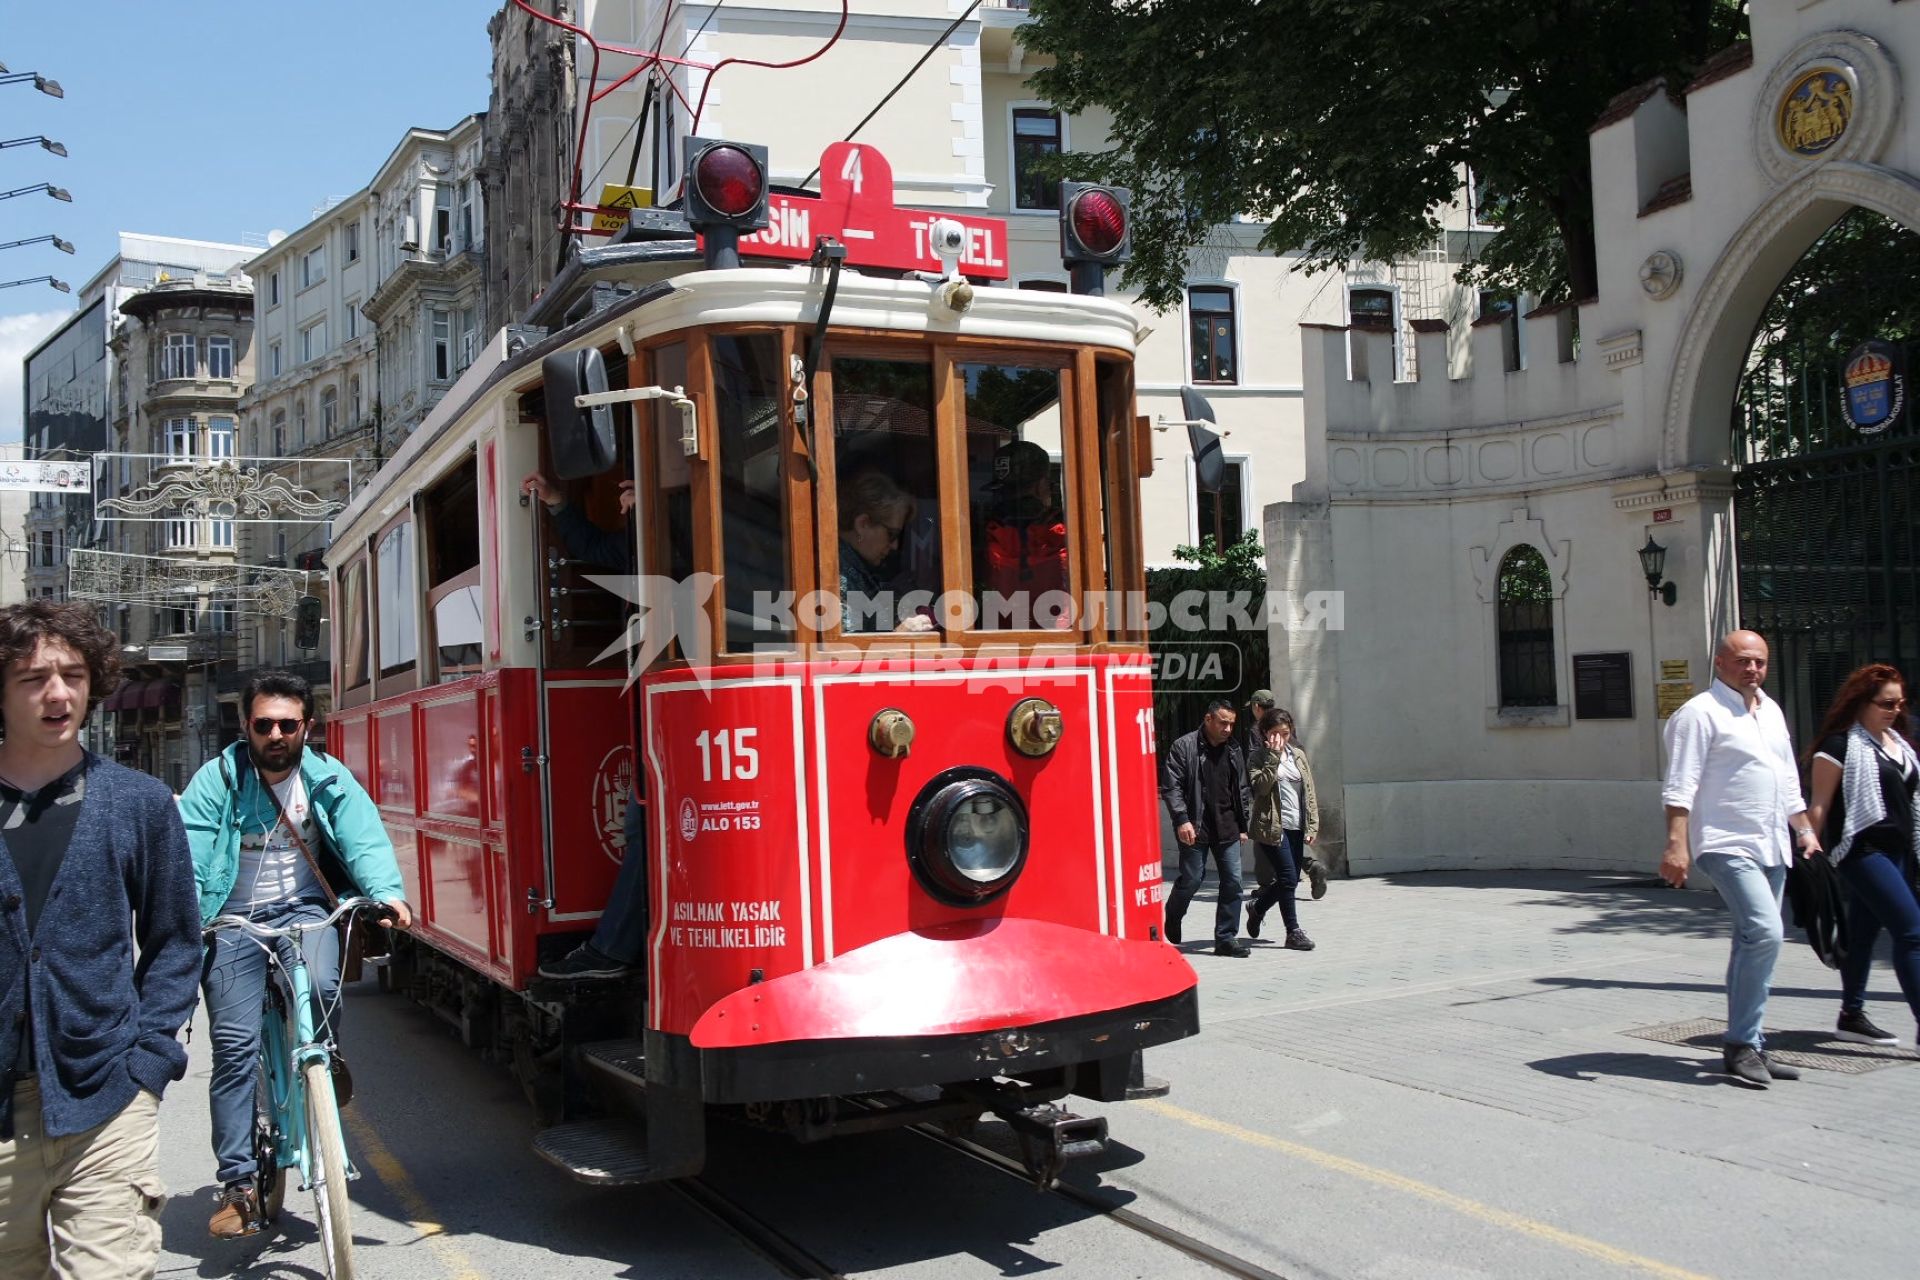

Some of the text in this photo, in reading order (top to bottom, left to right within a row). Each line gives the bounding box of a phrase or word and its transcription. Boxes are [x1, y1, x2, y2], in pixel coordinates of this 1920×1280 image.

[841, 148, 863, 194] 4
[740, 199, 810, 249] SİM
[909, 216, 1004, 268] TEL
[695, 727, 759, 782] 115
[701, 815, 761, 832] ALO 153
[1135, 887, 1149, 907] VE
[673, 900, 781, 922] ASILMAK YASAK
[669, 923, 786, 948] VE TEHLİKELİDİR
